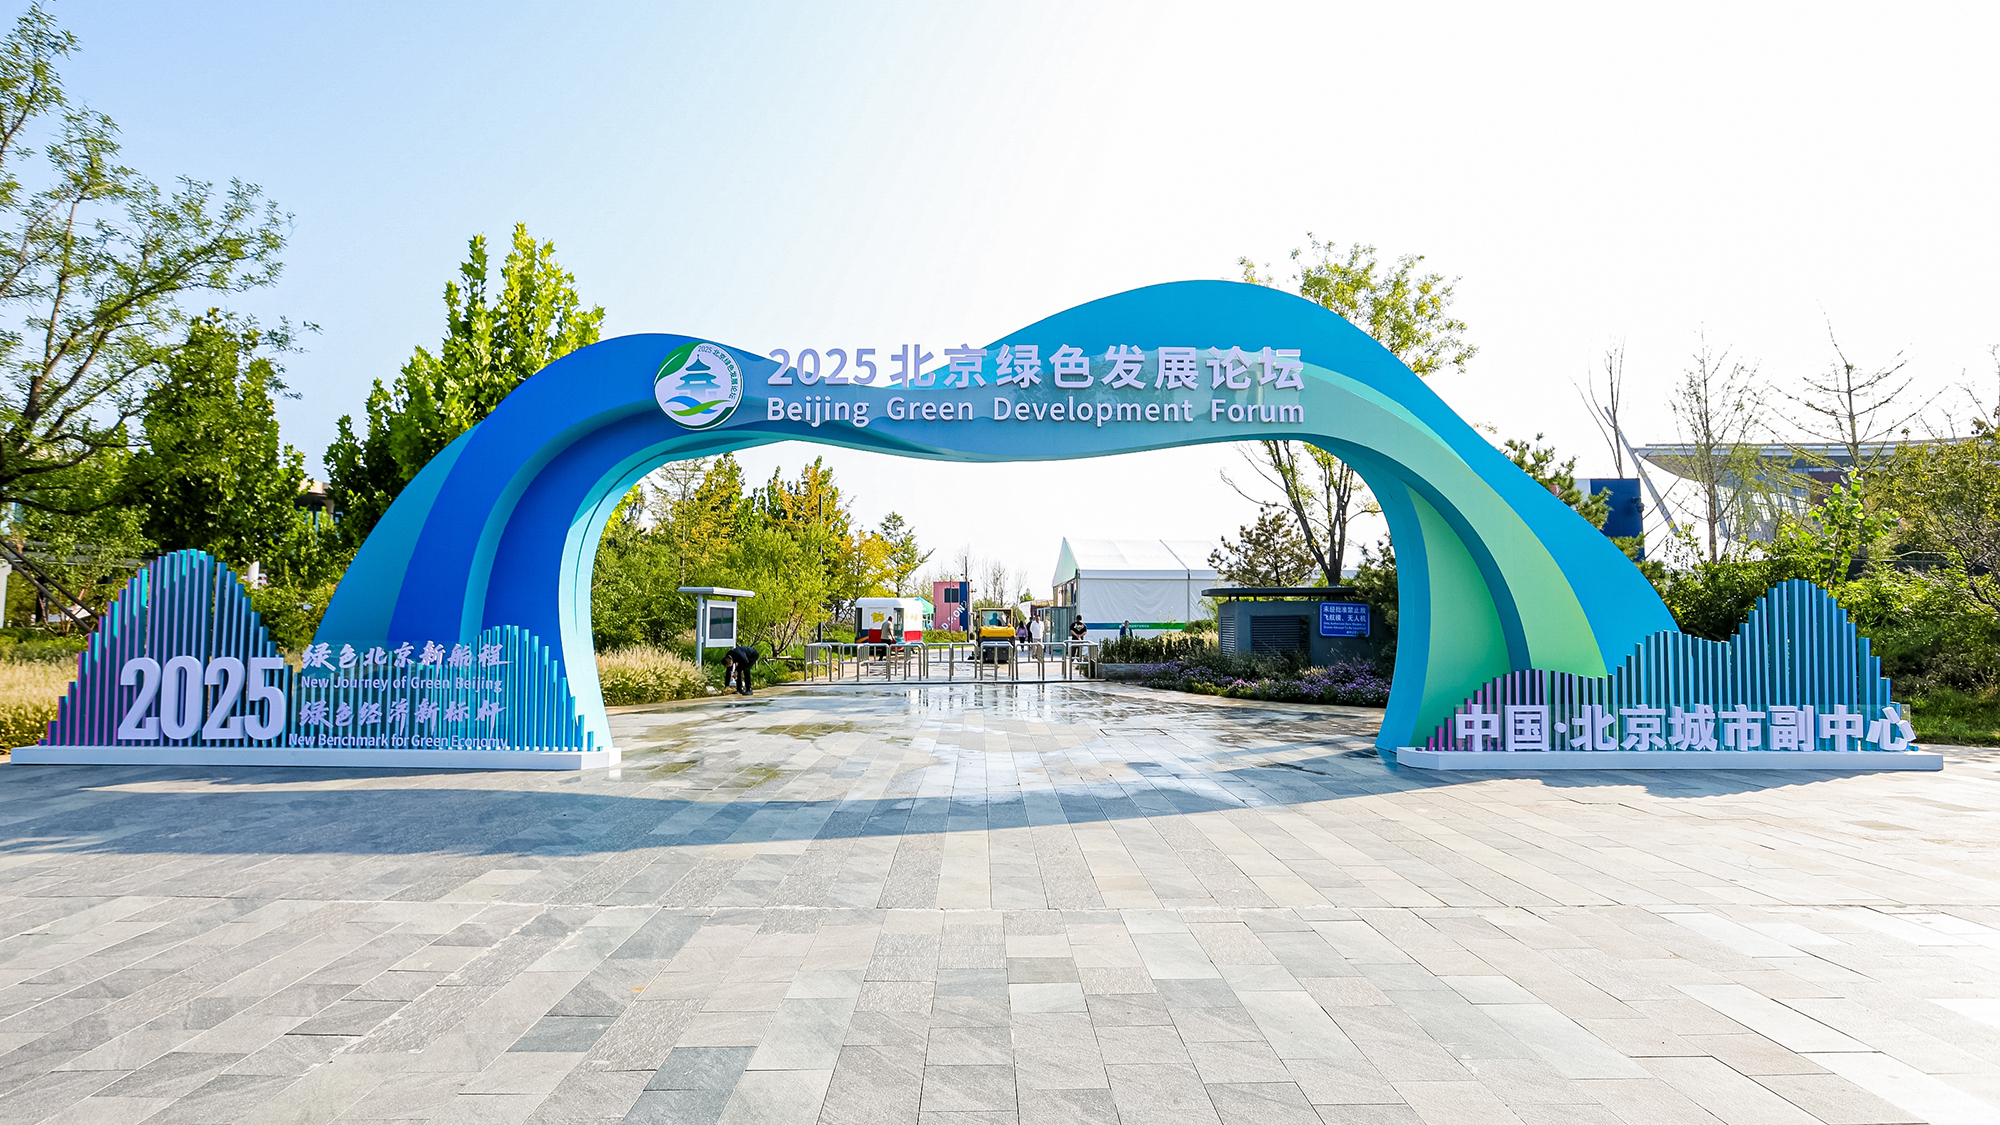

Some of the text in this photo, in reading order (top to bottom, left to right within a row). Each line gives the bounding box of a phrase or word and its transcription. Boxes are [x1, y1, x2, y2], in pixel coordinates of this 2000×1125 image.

[767, 343, 1305, 390] 2025北京绿色发展论坛
[767, 395, 1305, 428] Beijing Green Development Forum
[1323, 606, 1366, 614] 未经批准禁止放
[301, 640, 514, 677] 绿色北京新航程
[117, 655, 286, 740] 2025
[301, 676, 503, 693] New Journey of Green Beijing
[299, 697, 507, 739] 绿色经济新标杆
[1455, 703, 1916, 752] 中国·北京城市副中心
[288, 733, 508, 750] New Benchmark for Green Economy
